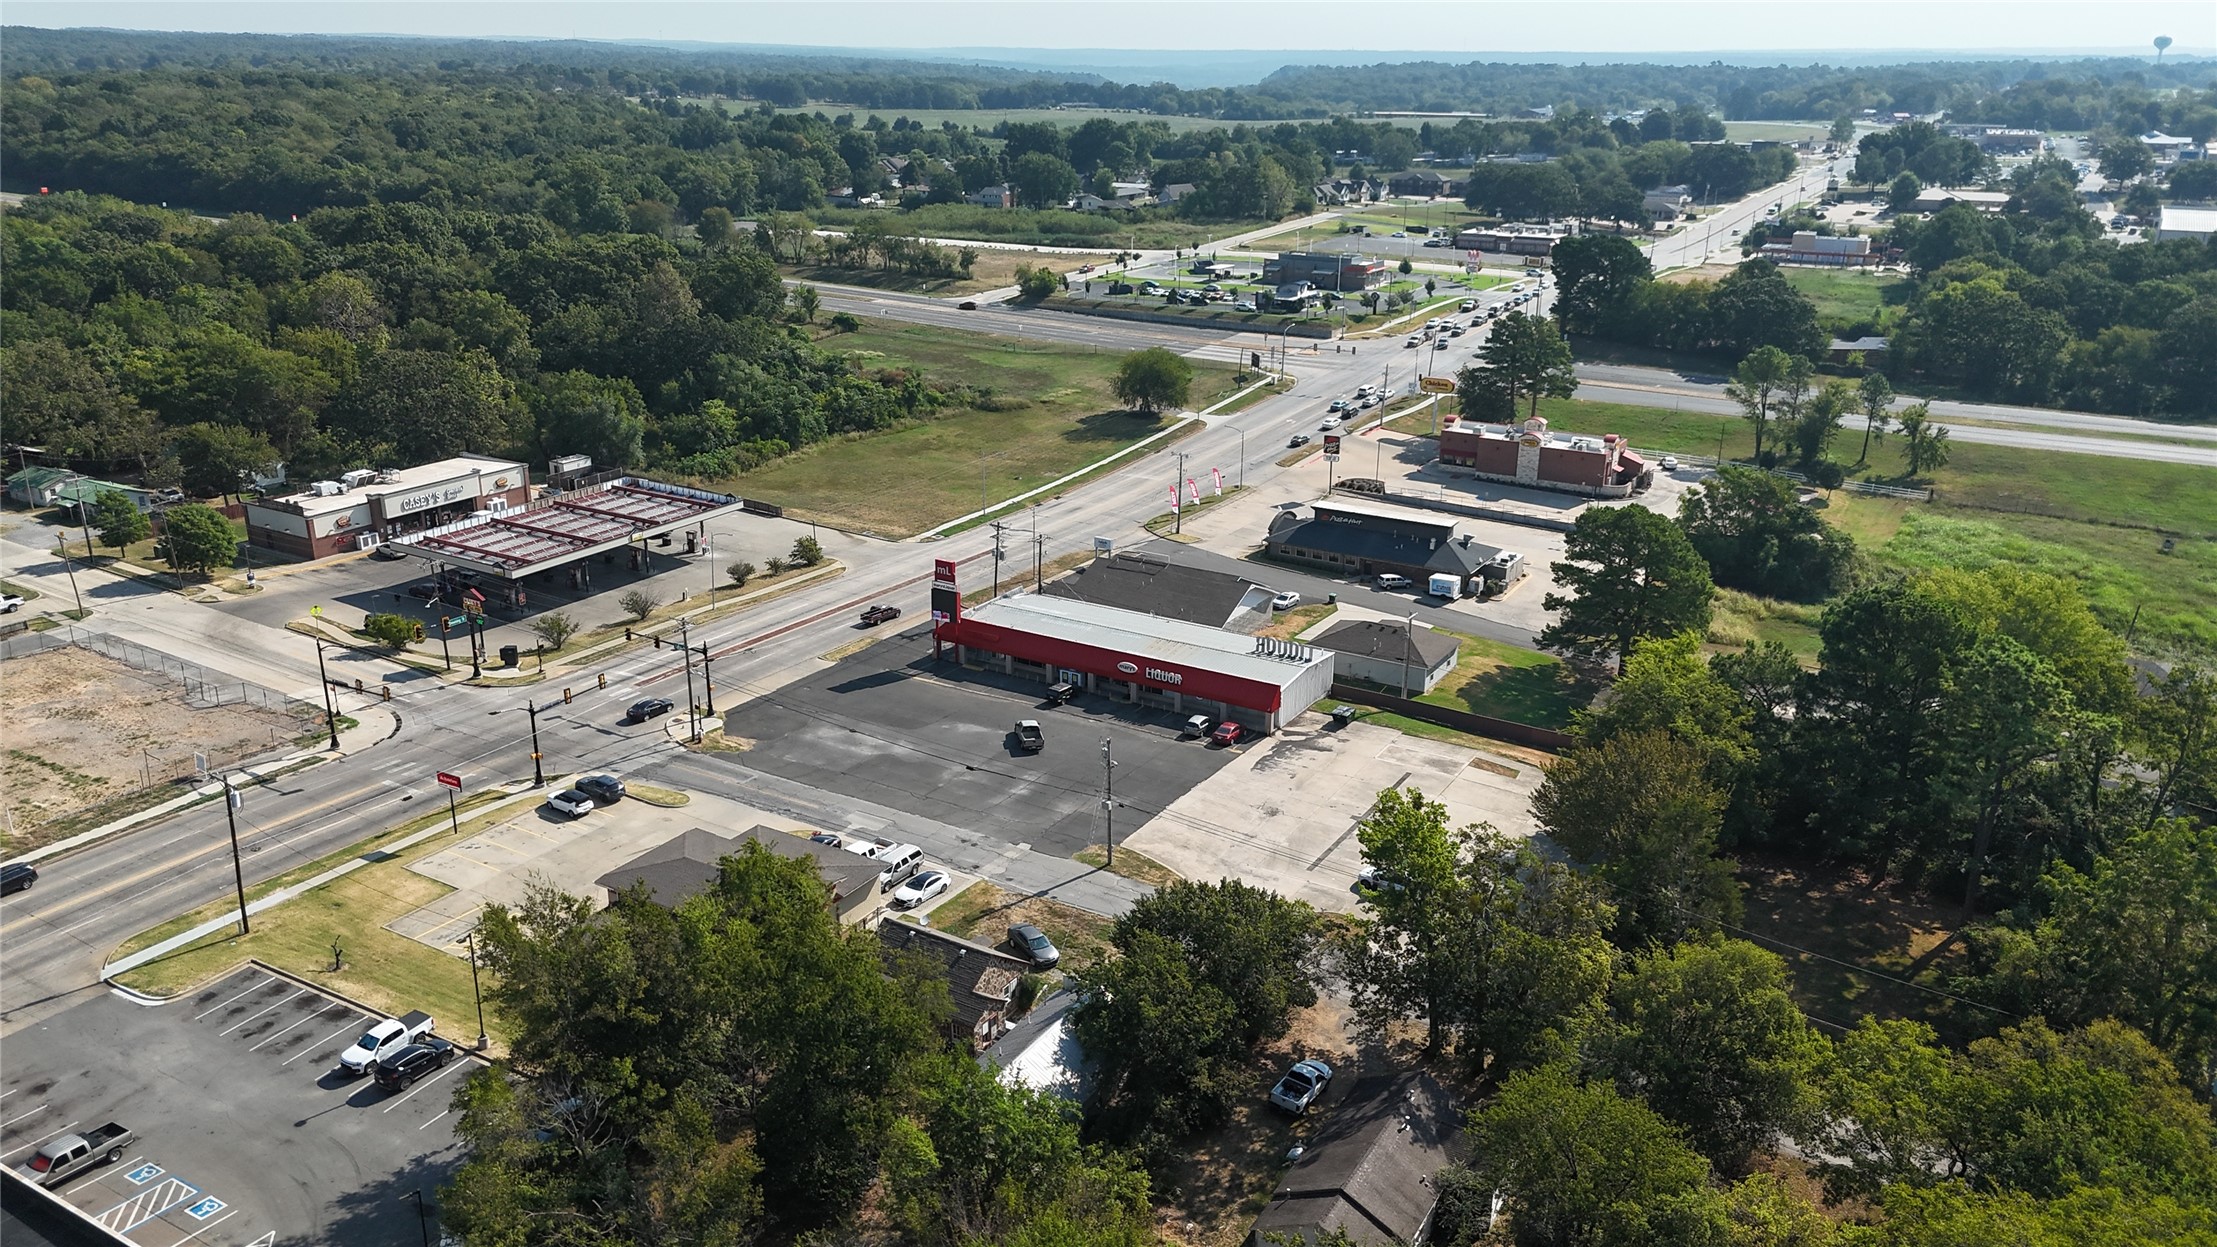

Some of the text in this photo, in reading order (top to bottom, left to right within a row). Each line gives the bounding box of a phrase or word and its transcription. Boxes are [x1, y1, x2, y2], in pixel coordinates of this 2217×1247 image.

[403, 491, 441, 510] CASEY'S
[937, 566, 951, 575] mL
[1146, 667, 1183, 685] LIQUOR
